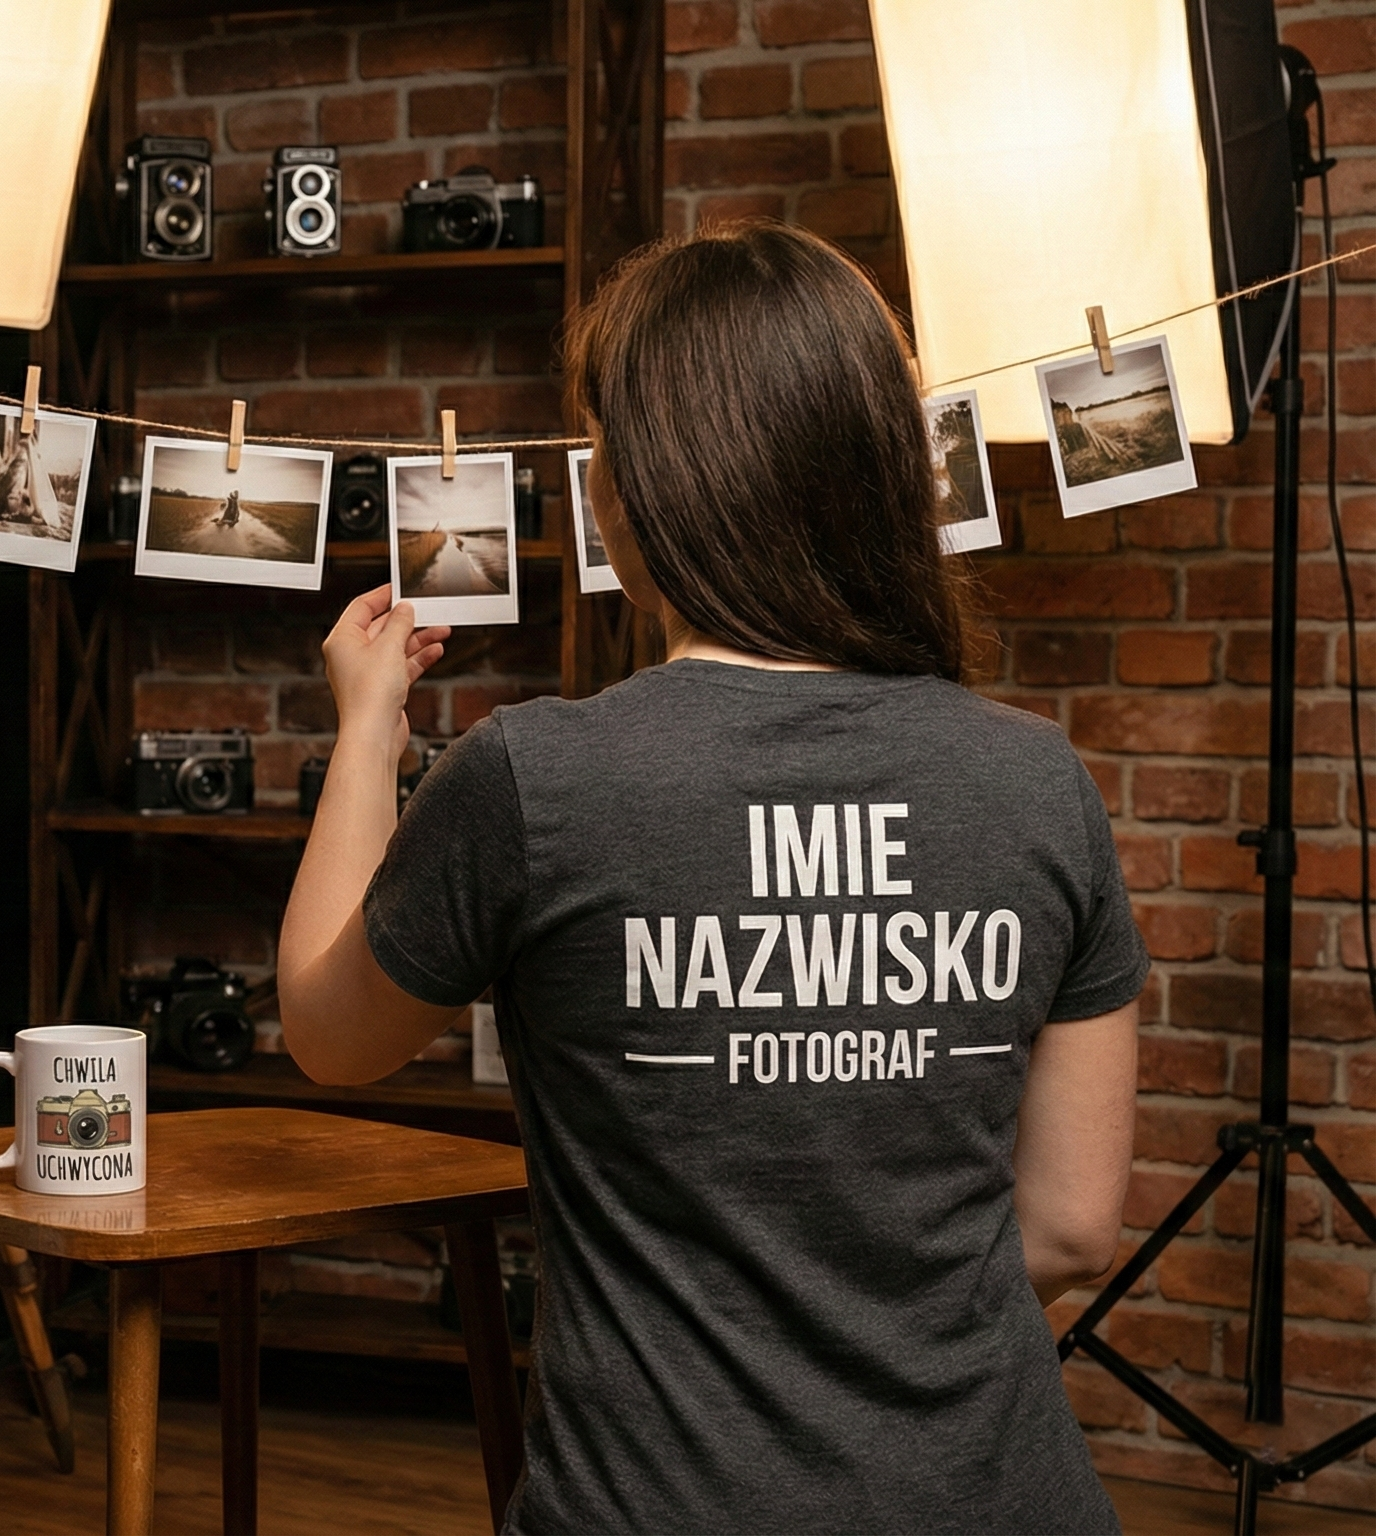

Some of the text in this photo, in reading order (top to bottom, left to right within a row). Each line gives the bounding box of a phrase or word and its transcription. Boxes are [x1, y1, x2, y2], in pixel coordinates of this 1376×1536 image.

[748, 802, 913, 898] IMIE
[625, 908, 1022, 1009] NAZWISKO
[53, 1056, 116, 1084] CHWILA
[728, 1028, 938, 1084] FOTOGRAF
[36, 1152, 133, 1181] UCHWYCONA
